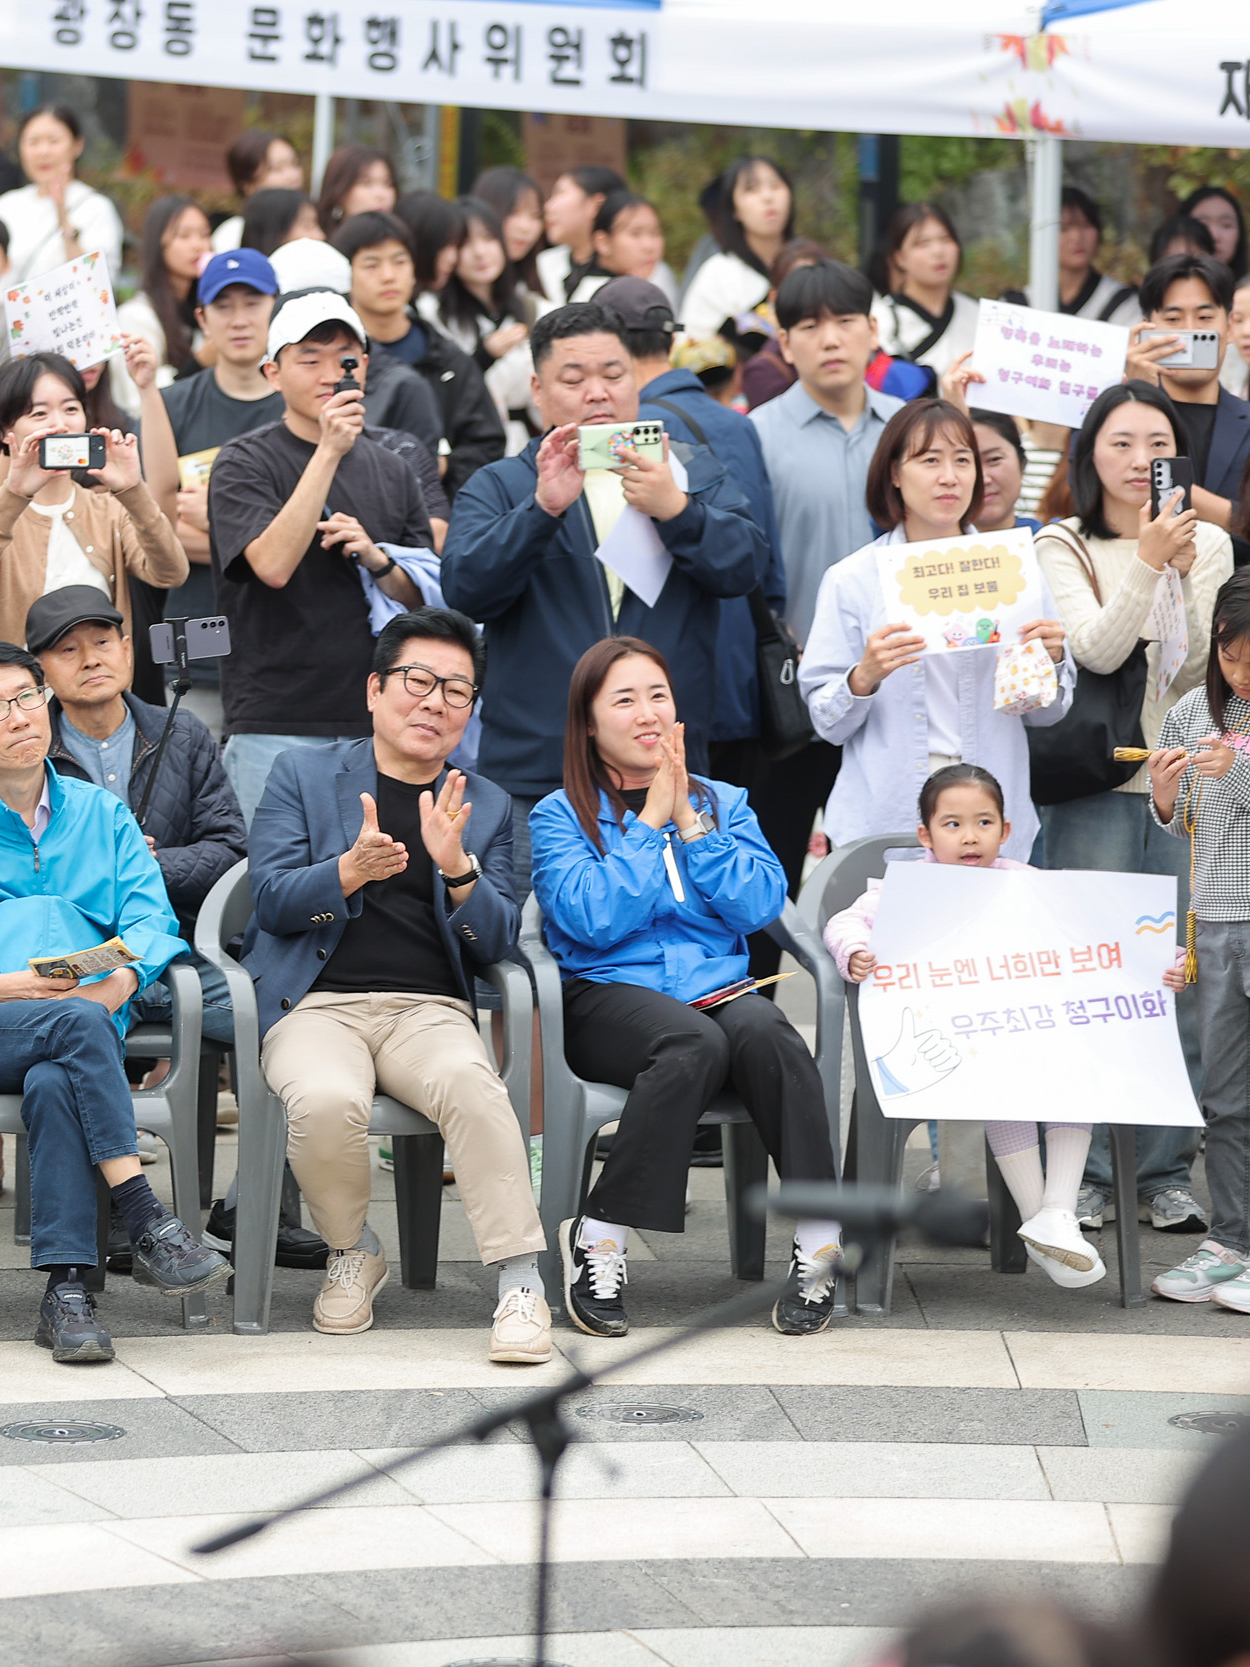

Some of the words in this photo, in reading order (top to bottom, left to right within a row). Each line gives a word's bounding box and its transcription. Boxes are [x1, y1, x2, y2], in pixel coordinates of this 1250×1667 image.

[249, 8, 647, 90] 문화행사위원회
[913, 562, 954, 579] 최고다!
[959, 556, 1001, 573] 잘한다!
[928, 586, 953, 600] 우리
[957, 584, 970, 597] 집
[974, 581, 999, 594] 보물
[871, 963, 921, 993] 우리
[928, 957, 980, 989] 눈엔
[986, 949, 1062, 982] 너희만
[1070, 941, 1123, 974] 보여
[951, 1003, 1057, 1040] 우주최강
[1061, 989, 1168, 1026] 청구이화
